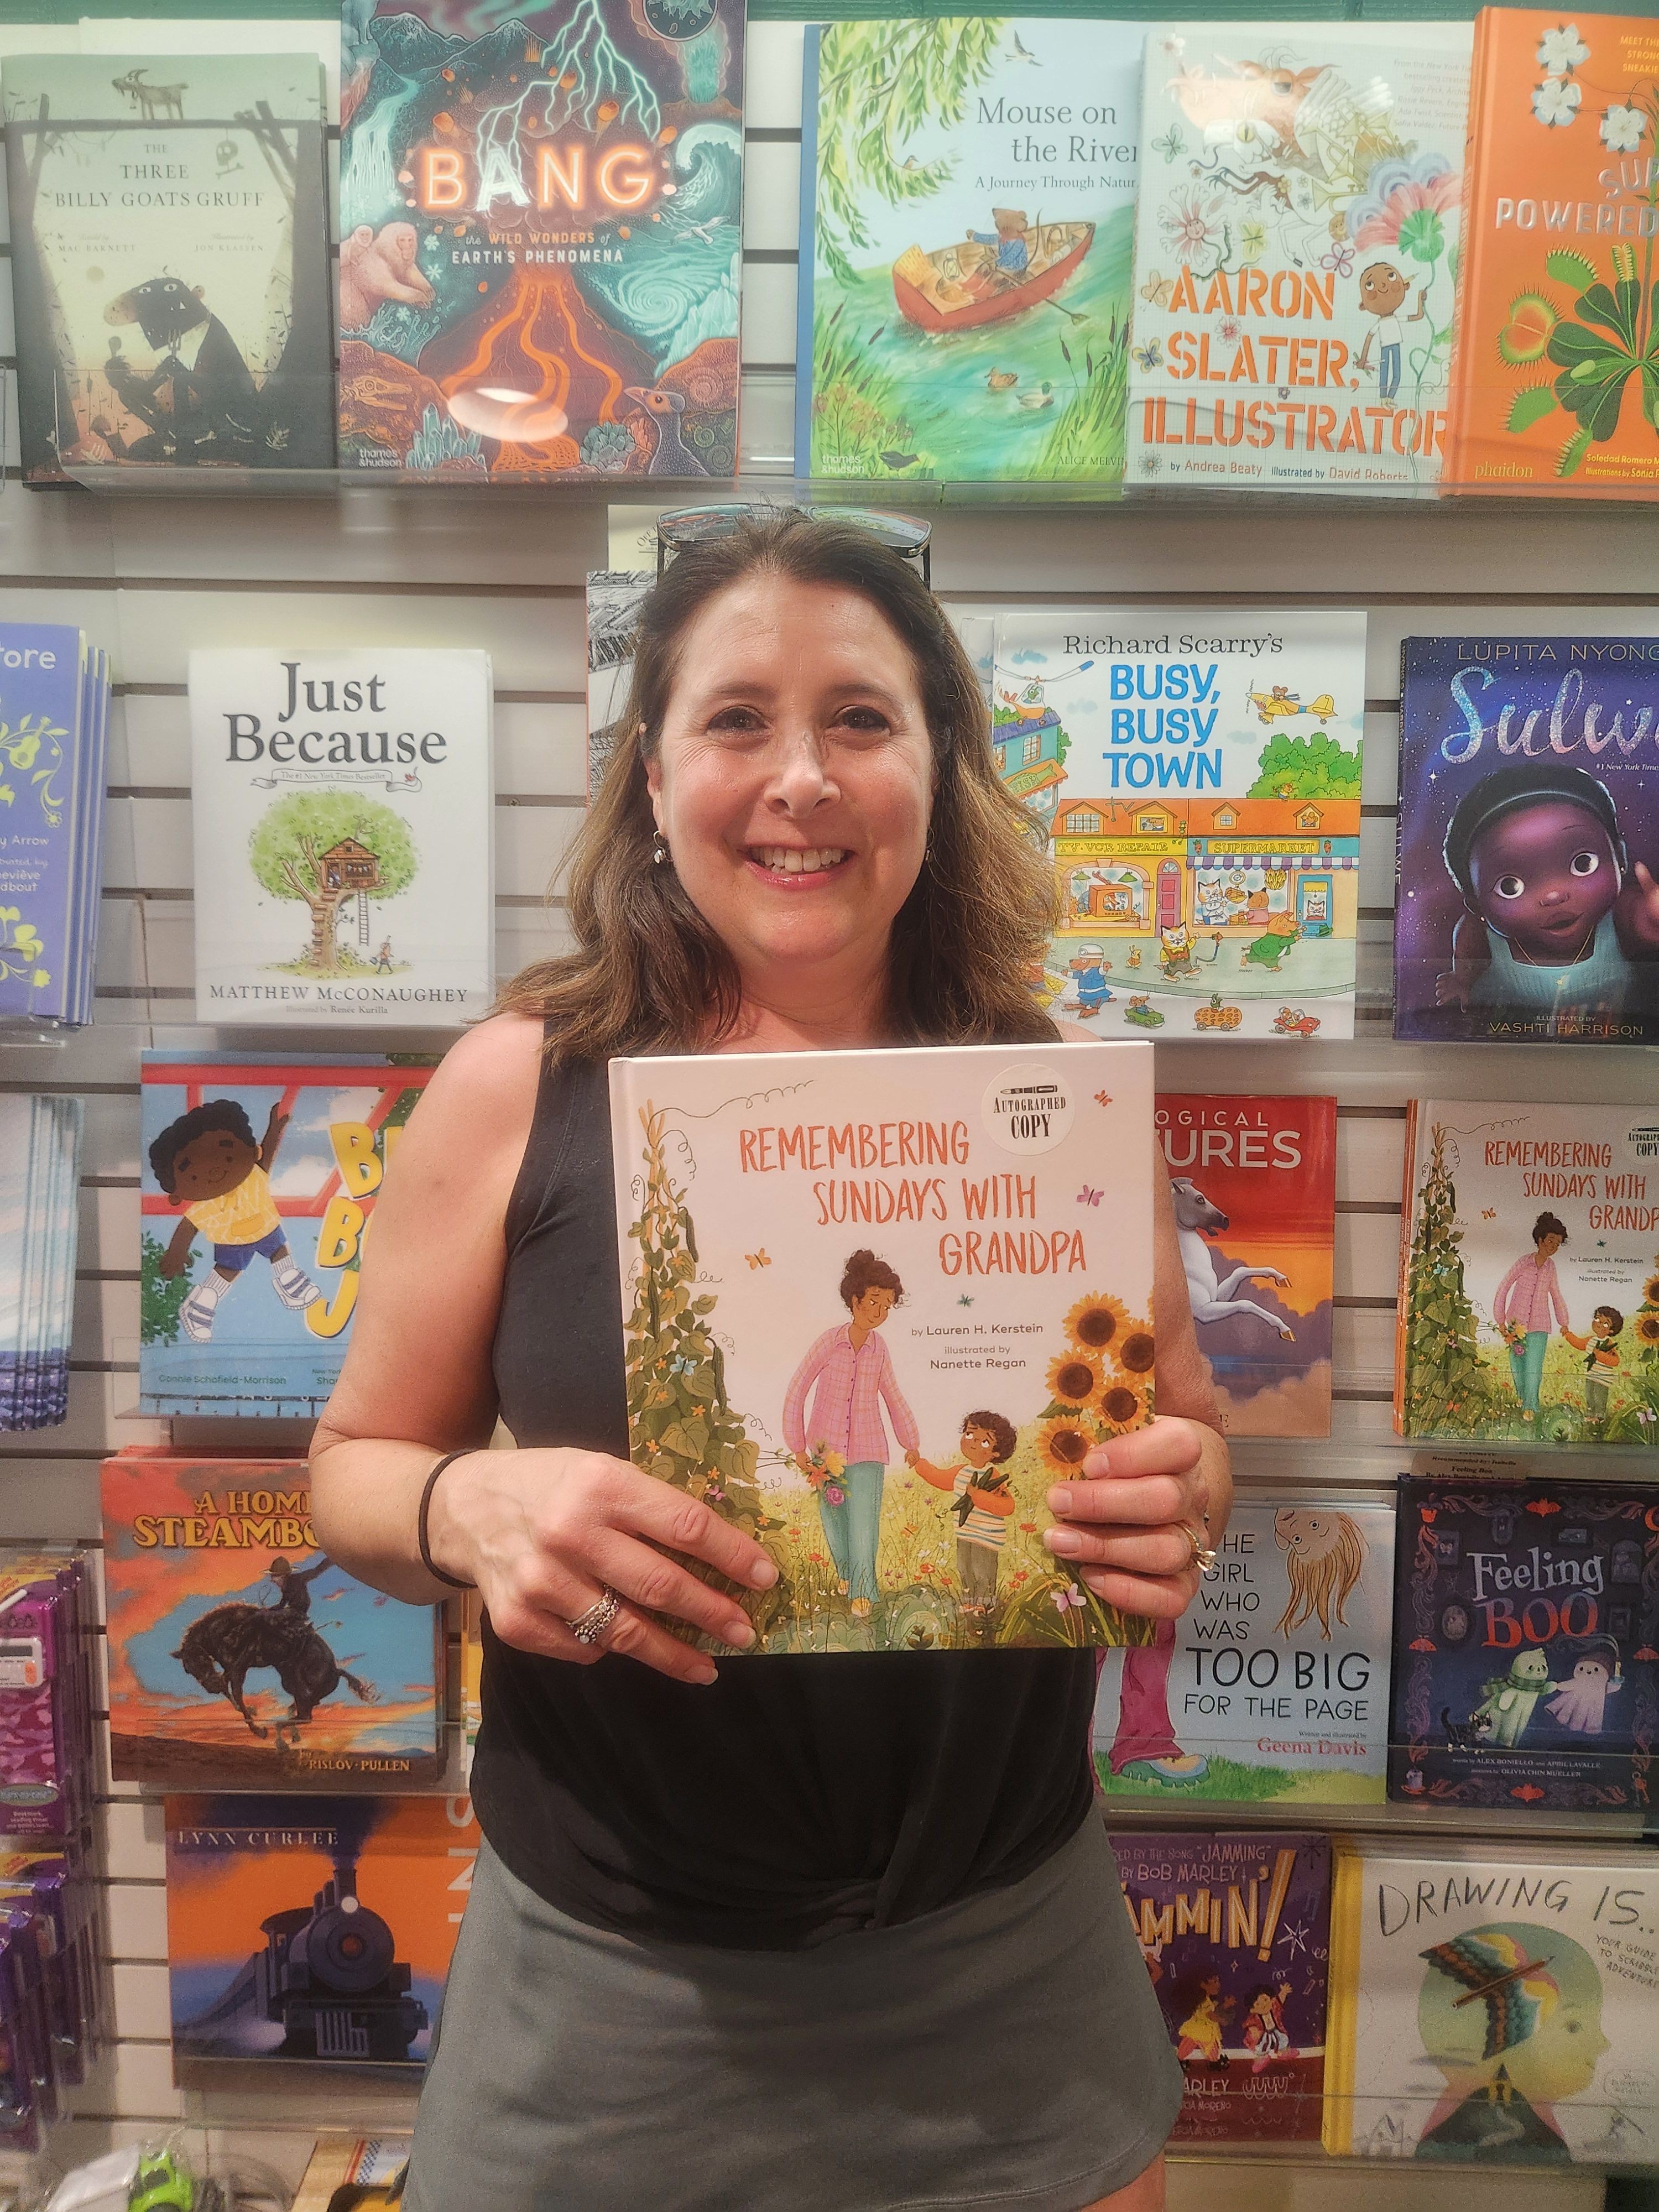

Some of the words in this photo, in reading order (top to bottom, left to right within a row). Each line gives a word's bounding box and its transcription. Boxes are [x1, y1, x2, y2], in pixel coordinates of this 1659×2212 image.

[977, 97, 1072, 124] Mouse
[1082, 106, 1117, 124] on
[144, 144, 168, 153] THE
[1011, 135, 1057, 163] the
[119, 164, 189, 179] THREE
[427, 148, 651, 211] BANG
[975, 176, 985, 189] A
[987, 176, 1037, 192] Journey
[1040, 175, 1094, 191] Through
[1099, 176, 1139, 189] Natur
[55, 192, 112, 207] BILLY
[121, 191, 190, 207] GOATS
[196, 191, 265, 207] GRUFF
[465, 234, 482, 246] the
[488, 233, 522, 245] WILD
[530, 232, 595, 244] WONDERS
[600, 232, 612, 246] of
[452, 250, 515, 264] EARTH'S
[525, 249, 623, 264] PHENOMENA
[1168, 266, 1335, 321] AARON
[1166, 331, 1360, 392] SLATER,
[359, 448, 398, 458] thames
[359, 458, 403, 468] &hudson
[822, 453, 861, 464] thames
[1057, 456, 1087, 466] ALICE
[1586, 453, 1620, 463] Soledad
[1621, 456, 1652, 465] Romero
[821, 463, 865, 474] &hudson
[1171, 462, 1180, 472] by
[1184, 460, 1225, 473] Andrea
[1230, 462, 1262, 478] Beaty
[1315, 468, 1325, 480] by
[1329, 467, 1360, 481] David
[1475, 461, 1533, 479] phaidon
[1585, 467, 1621, 477] Illustrations
[1622, 469, 1630, 478] by
[1631, 468, 1653, 478] Sonia
[0, 641, 56, 670] ore
[1062, 635, 1172, 654] Richard
[1178, 633, 1283, 658] Scarry's
[1457, 644, 1557, 661] LUPITA
[278, 661, 387, 722] Just
[1110, 664, 1220, 705] BUSY,
[1441, 665, 1659, 765] Sulw
[1110, 708, 1219, 748] BUSY
[222, 713, 447, 764] Because
[1102, 749, 1222, 789] TOWN
[12, 834, 49, 846] Arrow
[1118, 842, 1168, 853] REPAIR
[1213, 841, 1315, 854] SUPERMARKET
[210, 985, 310, 1001] MATTHEW
[317, 986, 468, 1003] McCONAUGHEY
[320, 1006, 327, 1014] by
[358, 1006, 388, 1014] Kurilla
[1489, 1022, 1550, 1034] VASHTI
[1557, 1023, 1644, 1036] HARRISON
[993, 1097, 1067, 1114] AUTOGRAPHED
[1010, 1113, 1052, 1139] COPY
[1155, 1109, 1269, 1126] OGICAL
[739, 1120, 970, 1172] REMEMBERING
[1155, 1129, 1302, 1169] URES
[1484, 1140, 1612, 1168] REMEMBERING
[1523, 1172, 1597, 1199] SUNDAYS
[1605, 1173, 1646, 1200] WITH
[812, 1177, 947, 1225] SUNDAYS
[961, 1173, 1036, 1221] WITH
[939, 1229, 1087, 1275] GRANDPA
[911, 1328, 923, 1338] by
[926, 1326, 970, 1335] Lauren
[974, 1324, 987, 1334] H.
[992, 1323, 1044, 1334] Kerstein
[944, 1345, 995, 1354] illustrated
[998, 1345, 1010, 1355] by
[930, 1359, 982, 1369] Nanette
[985, 1358, 1026, 1370] Regan
[195, 1490, 218, 1514] A
[1223, 1533, 1255, 1553] HE
[1203, 1563, 1255, 1583] GIRL
[1466, 1546, 1604, 1601] Feeling
[1200, 1590, 1260, 1611] WHO
[1193, 1618, 1250, 1641] WAS
[1474, 1591, 1598, 1648] BOO
[1185, 1647, 1279, 1688] TOO
[1295, 1650, 1371, 1691] BIG
[1184, 1693, 1231, 1715] FOR
[1244, 1697, 1292, 1718] THE
[1306, 1699, 1369, 1721] PAGE
[1257, 1736, 1312, 1754] Geena
[1318, 1739, 1367, 1755] Davis
[360, 1760, 410, 1771] PULLEN
[178, 1830, 237, 1845] LYNN
[248, 1830, 339, 1846] CURLEE
[1167, 1848, 1194, 1860] SONG
[1121, 1867, 1134, 1879] BY
[1138, 1863, 1173, 1881] BOB
[1177, 1863, 1239, 1886] MARLEY
[1379, 1876, 1573, 1937] DRAWING
[1596, 1934, 1621, 1949] YOUR
[1626, 1944, 1657, 1961] GUIDE
[1600, 1948, 1613, 1958] TO
